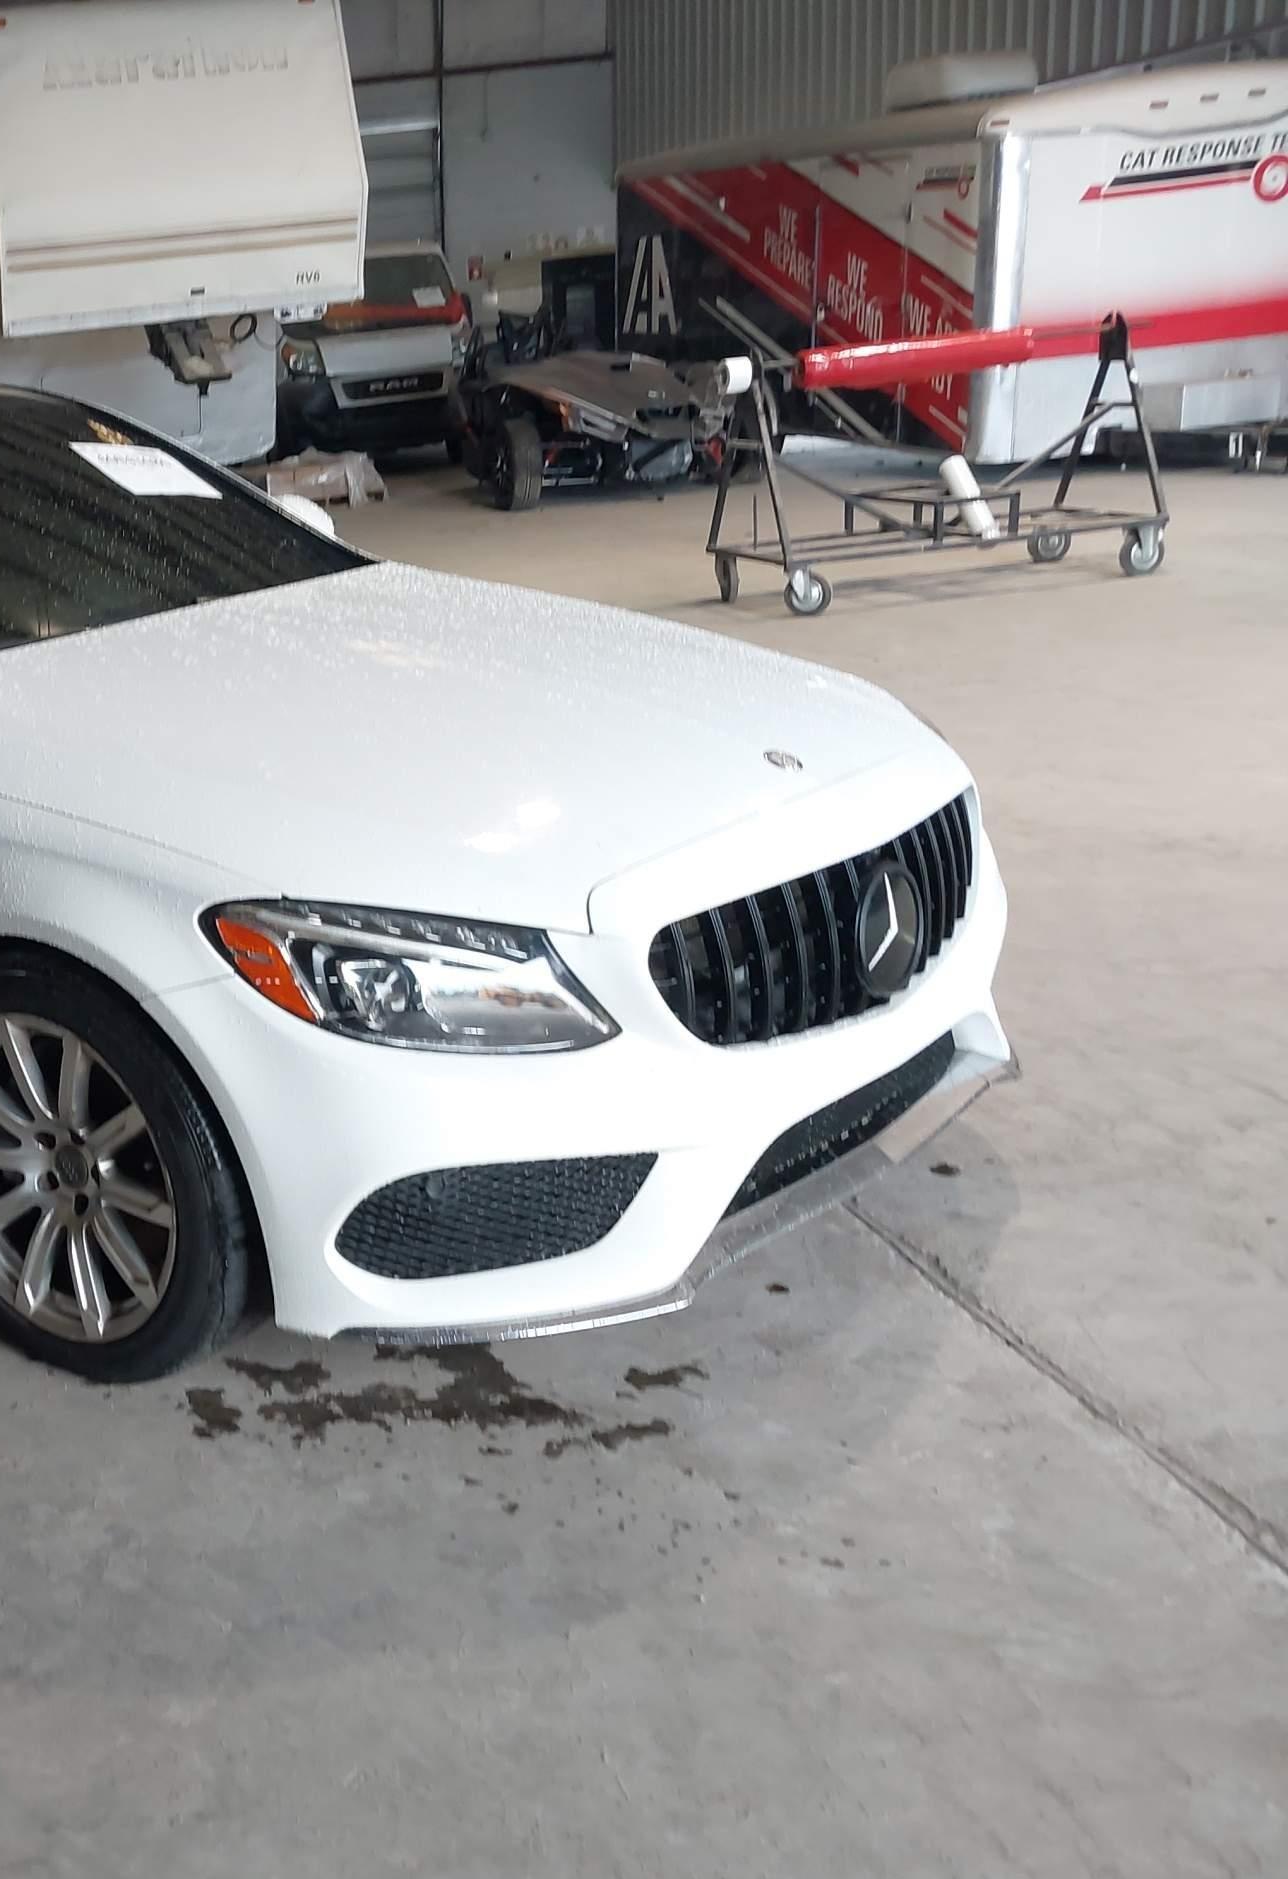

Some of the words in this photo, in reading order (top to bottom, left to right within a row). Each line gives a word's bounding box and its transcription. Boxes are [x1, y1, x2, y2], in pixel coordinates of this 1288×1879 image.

[1119, 148, 1158, 171] CAT
[1162, 135, 1265, 166] RESPONSE
[778, 204, 798, 240] WE
[763, 226, 812, 288] PREPARE
[847, 251, 868, 297] WE
[826, 274, 883, 343] RESPOND
[910, 293, 931, 338] WE
